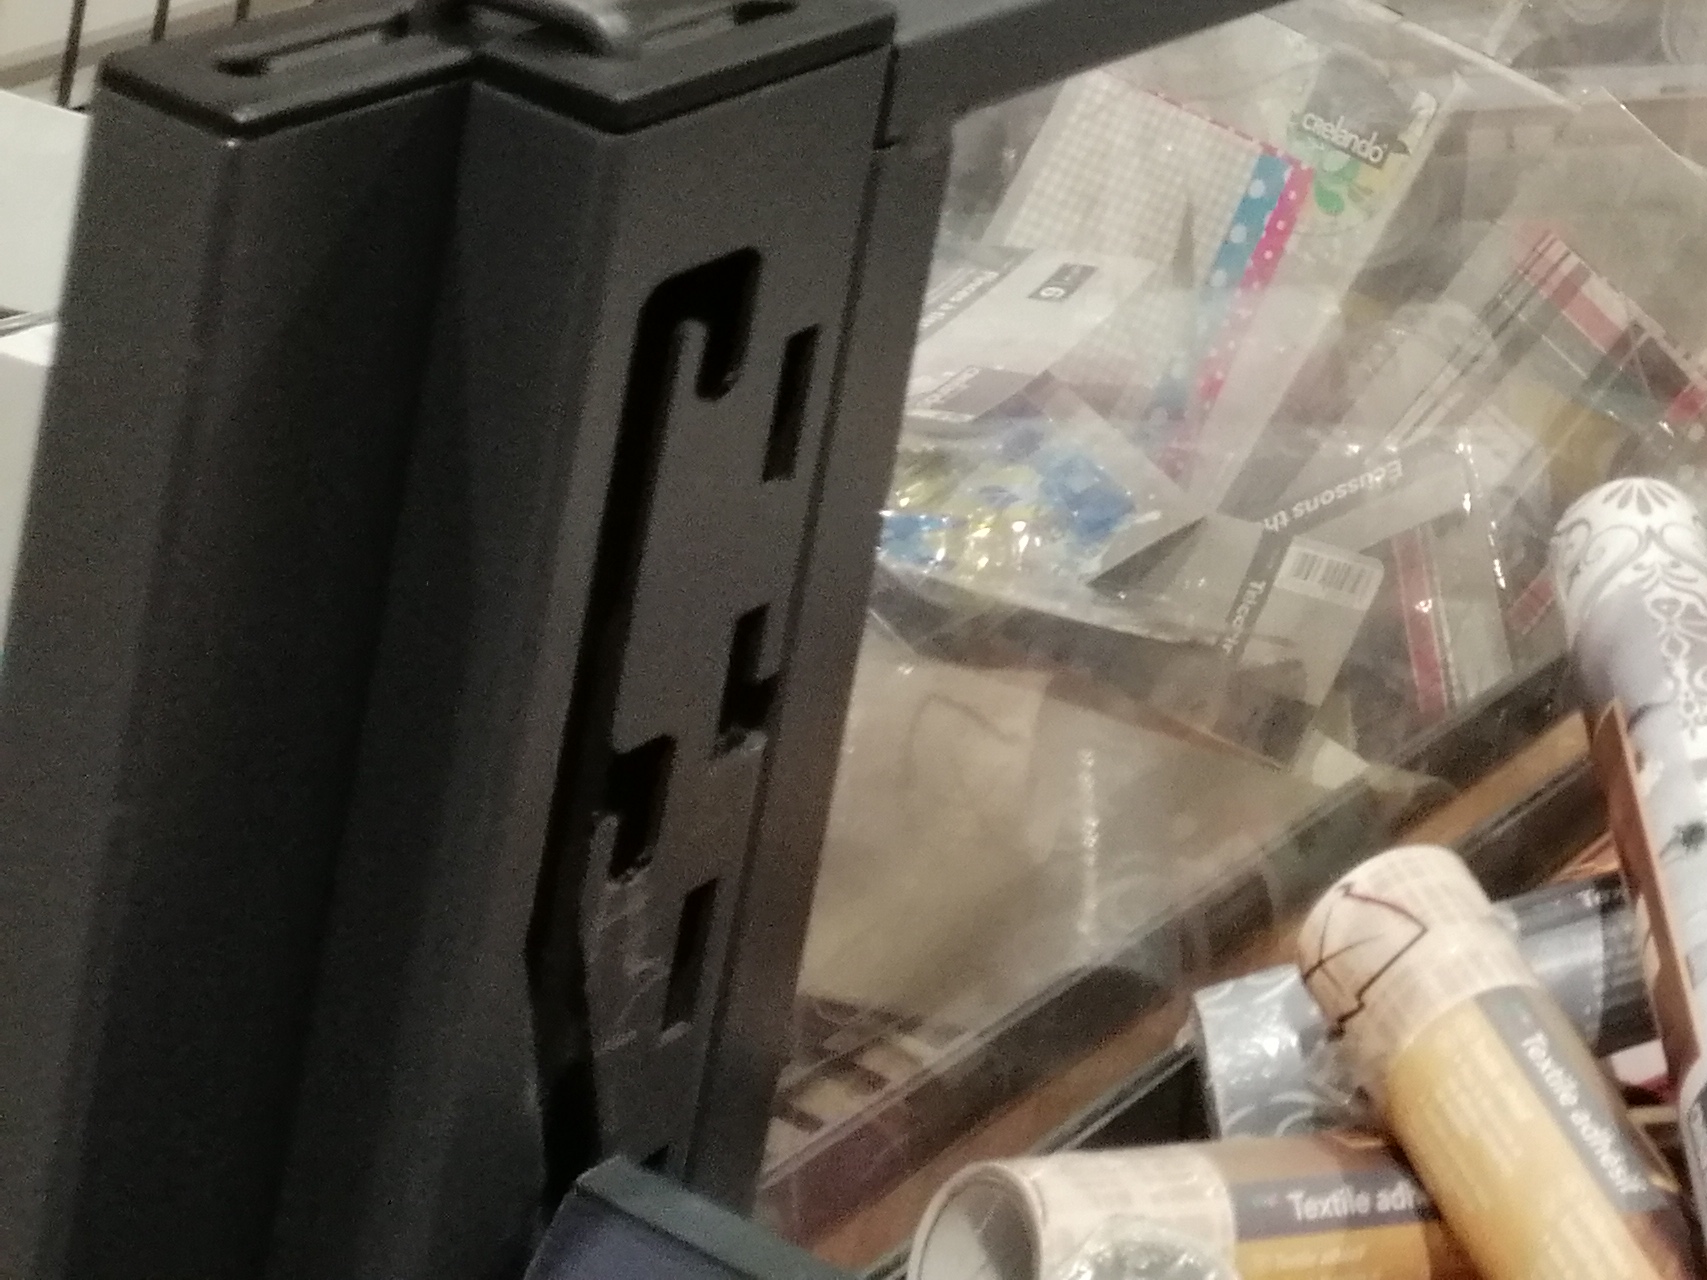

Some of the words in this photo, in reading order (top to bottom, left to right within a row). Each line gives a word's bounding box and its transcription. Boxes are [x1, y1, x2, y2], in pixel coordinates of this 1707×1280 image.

[1521, 1030, 1581, 1107] Textile
[1570, 1107, 1648, 1194] adhésif
[1285, 1187, 1372, 1221] Textile
